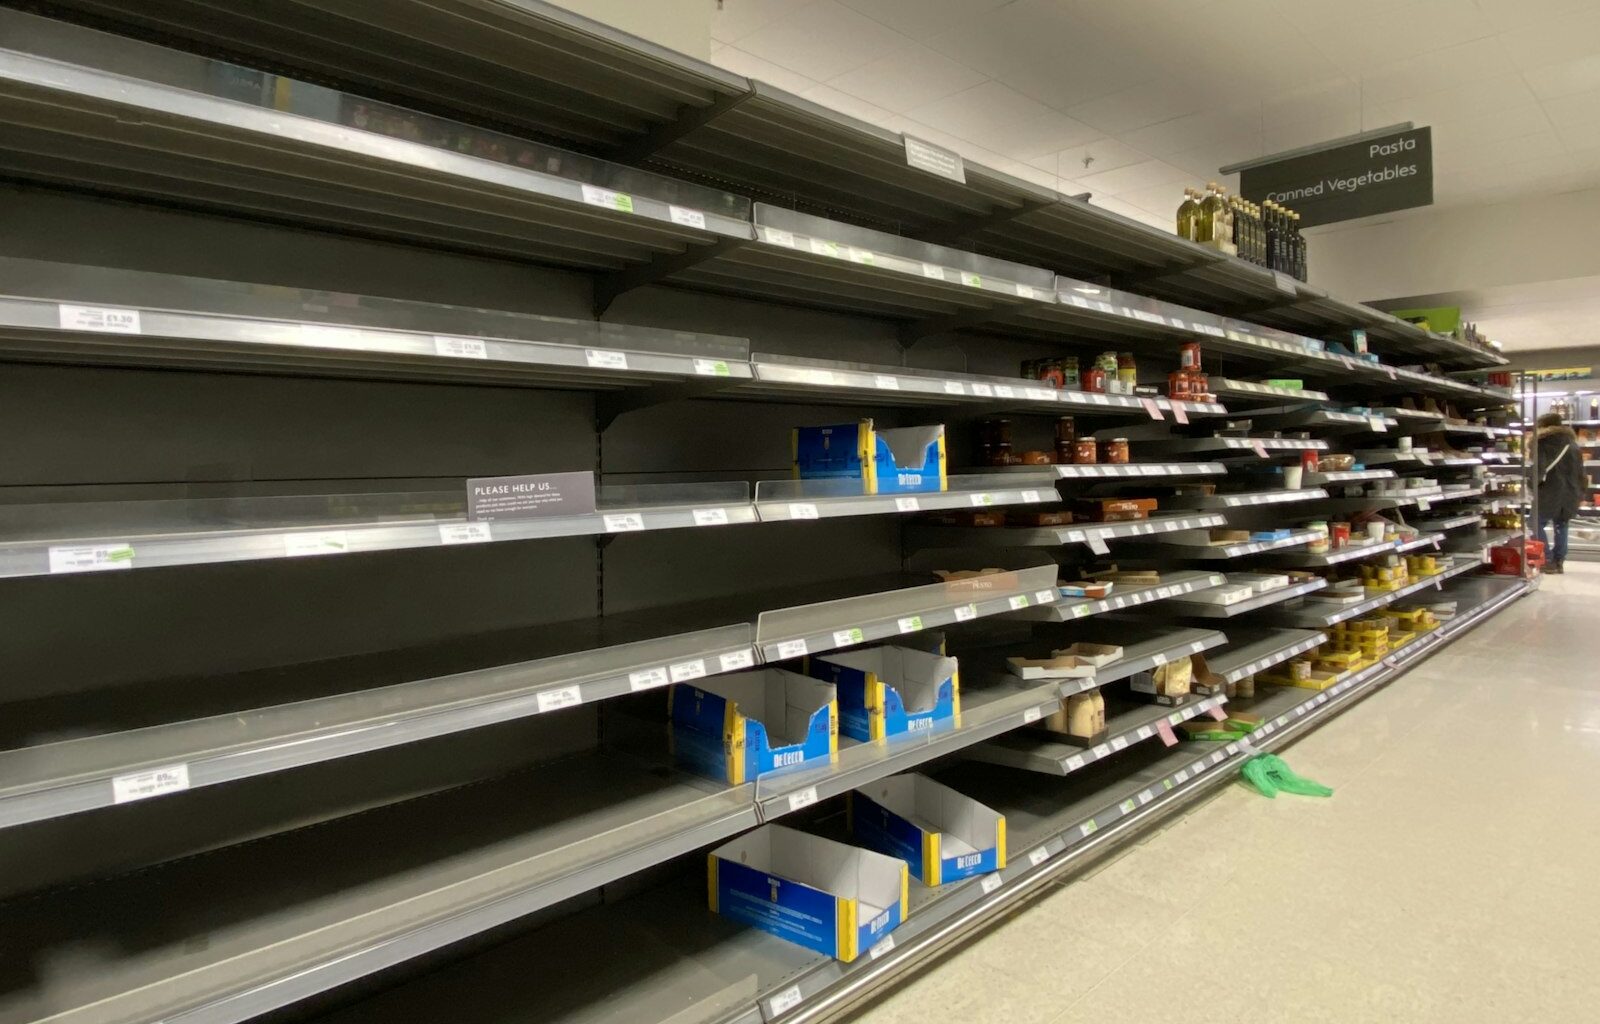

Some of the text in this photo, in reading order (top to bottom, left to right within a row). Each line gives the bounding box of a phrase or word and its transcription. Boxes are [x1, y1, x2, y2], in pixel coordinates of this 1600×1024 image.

[1369, 138, 1416, 158] Pasta
[1266, 164, 1417, 202] Canned Vegetables
[475, 485, 509, 496] PLEASE
[512, 483, 536, 493] HELP
